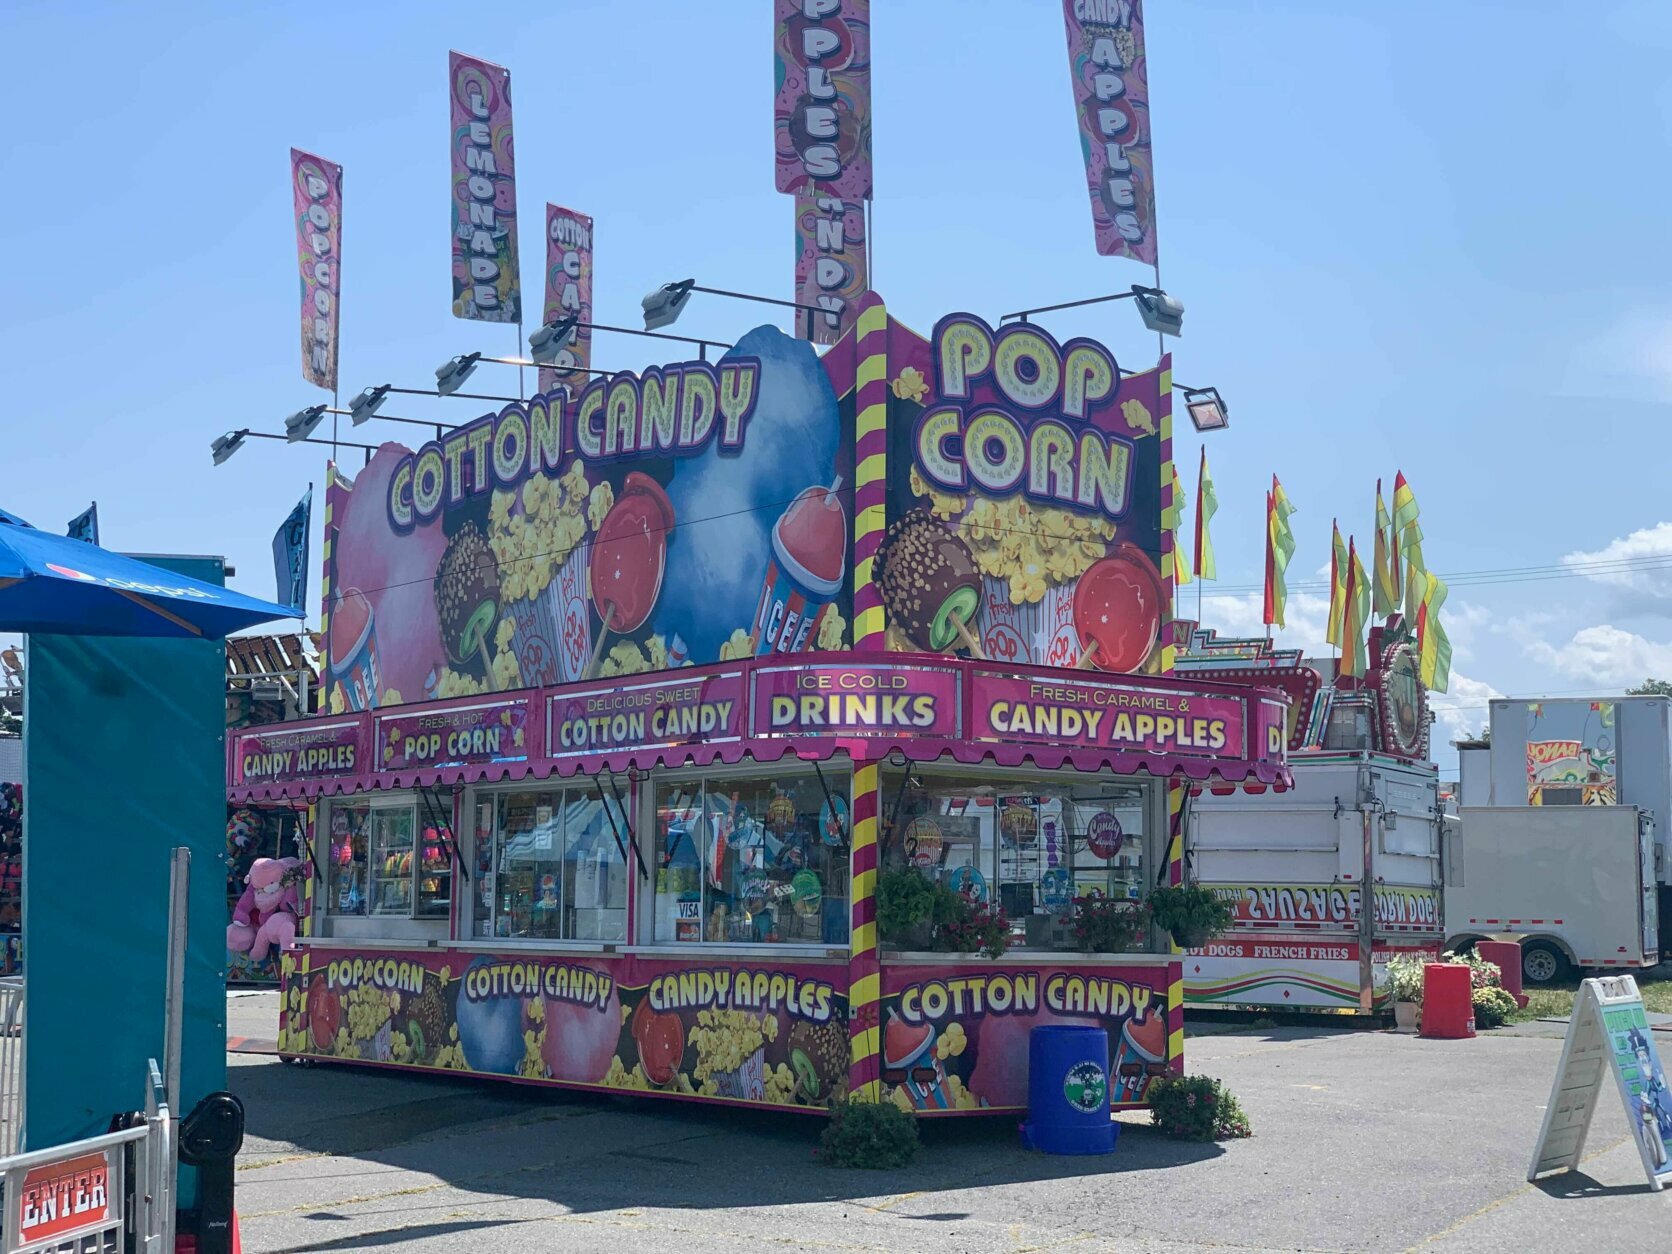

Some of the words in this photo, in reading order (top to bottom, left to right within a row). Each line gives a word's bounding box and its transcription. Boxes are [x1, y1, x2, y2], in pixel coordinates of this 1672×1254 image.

[1074, 0, 1131, 28] CANDY
[1091, 37, 1143, 242] APPLES
[465, 93, 500, 309] LEMONADE
[552, 217, 591, 252] COTTON
[305, 175, 331, 376] POPCORN
[940, 320, 1114, 420] POP
[391, 397, 566, 527] COTTON
[575, 362, 759, 456] CANDY
[918, 408, 1133, 516] CORN
[758, 585, 815, 653] ICEE
[989, 593, 1015, 620] fresh
[985, 630, 1018, 662] POP
[796, 674, 832, 689] ICE
[834, 673, 908, 689] COLD
[587, 695, 652, 713] DELICIOUS
[656, 687, 700, 704] SWEET
[771, 695, 936, 728] DRINKS
[1030, 684, 1088, 703] FRESH
[1093, 690, 1175, 712] CARAMEL
[1178, 699, 1190, 713] &
[419, 717, 450, 729] FRESH
[452, 716, 460, 725] &
[461, 713, 484, 725] HOT
[560, 712, 645, 748] COTTON
[652, 701, 733, 738] CANDY
[989, 701, 1103, 739] CANDY
[1111, 712, 1227, 750] APPLES
[260, 737, 287, 749] FRESH
[288, 734, 328, 747] CARAMEL
[329, 731, 337, 741] &
[404, 734, 441, 761] POP
[447, 728, 500, 757] CORN
[243, 752, 292, 777] CANDY
[296, 746, 355, 772] APPLES
[680, 902, 699, 918] VISA
[1208, 944, 1244, 957] DOGS
[1254, 945, 1307, 959] FRENCH
[1310, 947, 1349, 960] FRIES
[328, 960, 363, 989] POP
[373, 960, 424, 994] CORN
[467, 962, 541, 998] COTTON
[544, 964, 612, 1009] CANDY
[649, 968, 731, 1011] CANDY
[734, 969, 833, 1021] APPLES
[902, 974, 1037, 1021] COTTON
[1047, 976, 1150, 1020] CANDY
[22, 1166, 107, 1230] ENTER
